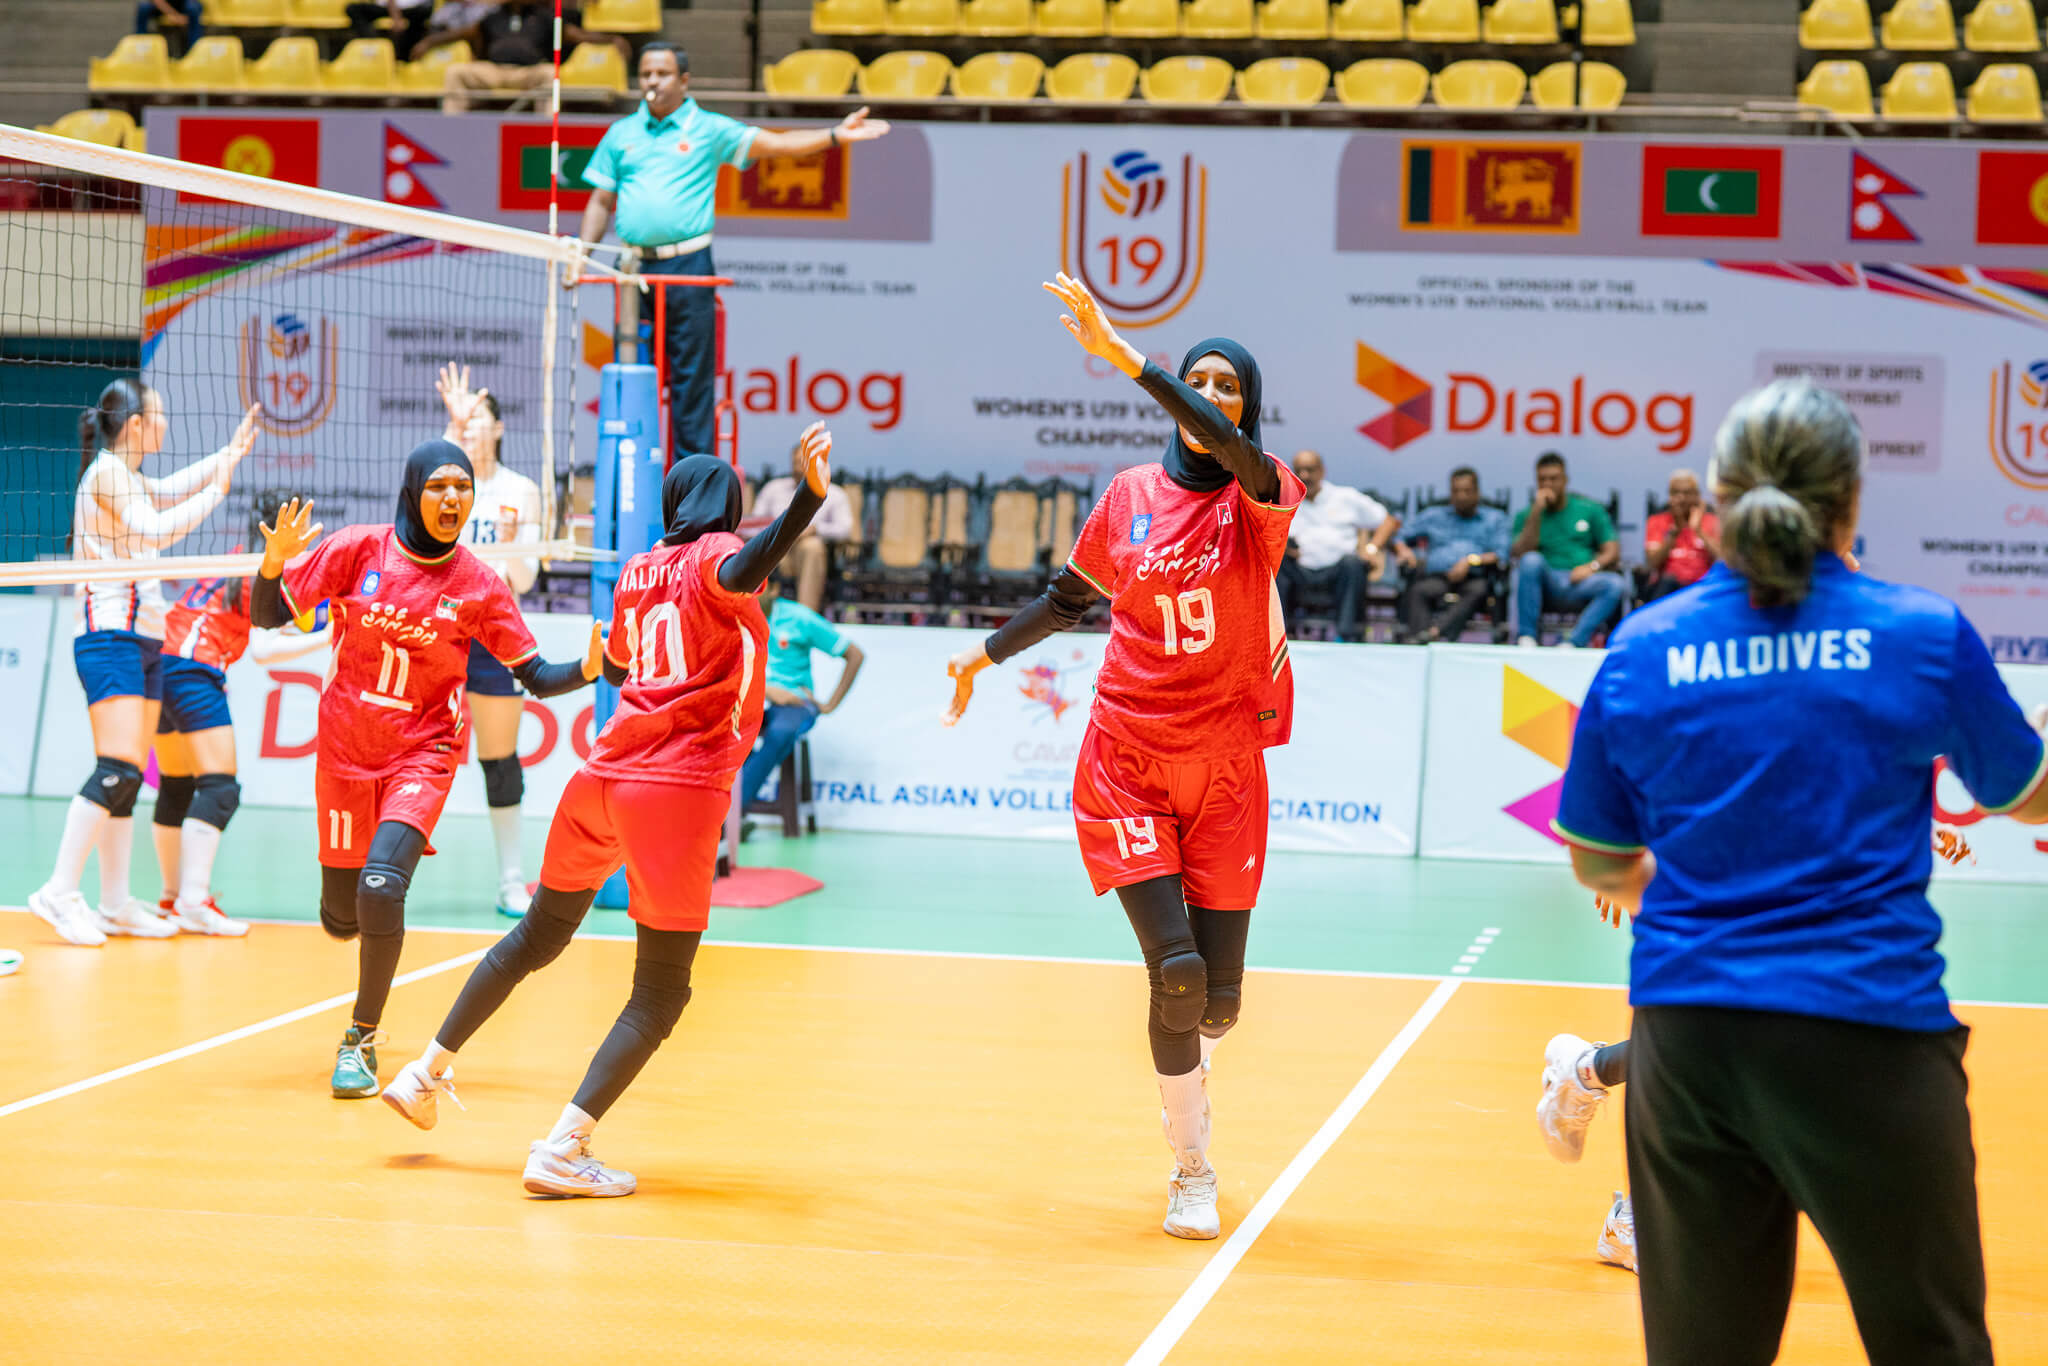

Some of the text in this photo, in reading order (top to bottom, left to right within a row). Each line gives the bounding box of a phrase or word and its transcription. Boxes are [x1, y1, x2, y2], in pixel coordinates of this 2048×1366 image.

[1097, 236, 1164, 287] 19
[1417, 276, 1636, 294] OFFICIAL SPONSOR OF THE
[1464, 295, 1546, 311] NATIONAL
[1551, 298, 1656, 314] VOLLEYBALL
[1661, 301, 1709, 316] TEAM
[267, 371, 311, 406] 19
[973, 398, 1085, 418] WOMEN'S
[1091, 399, 1129, 419] U19
[1446, 371, 1695, 454] Dialog
[1036, 426, 1171, 449] CHAMPION
[471, 517, 496, 544] 13
[1154, 587, 1216, 656] 19
[623, 601, 689, 686] 10
[1666, 628, 1873, 688] MALDIVES
[375, 640, 410, 698] 11
[891, 784, 980, 808] ASIAN
[1269, 798, 1382, 824] CIATION
[329, 809, 354, 850] 11
[1108, 816, 1159, 860] 19
